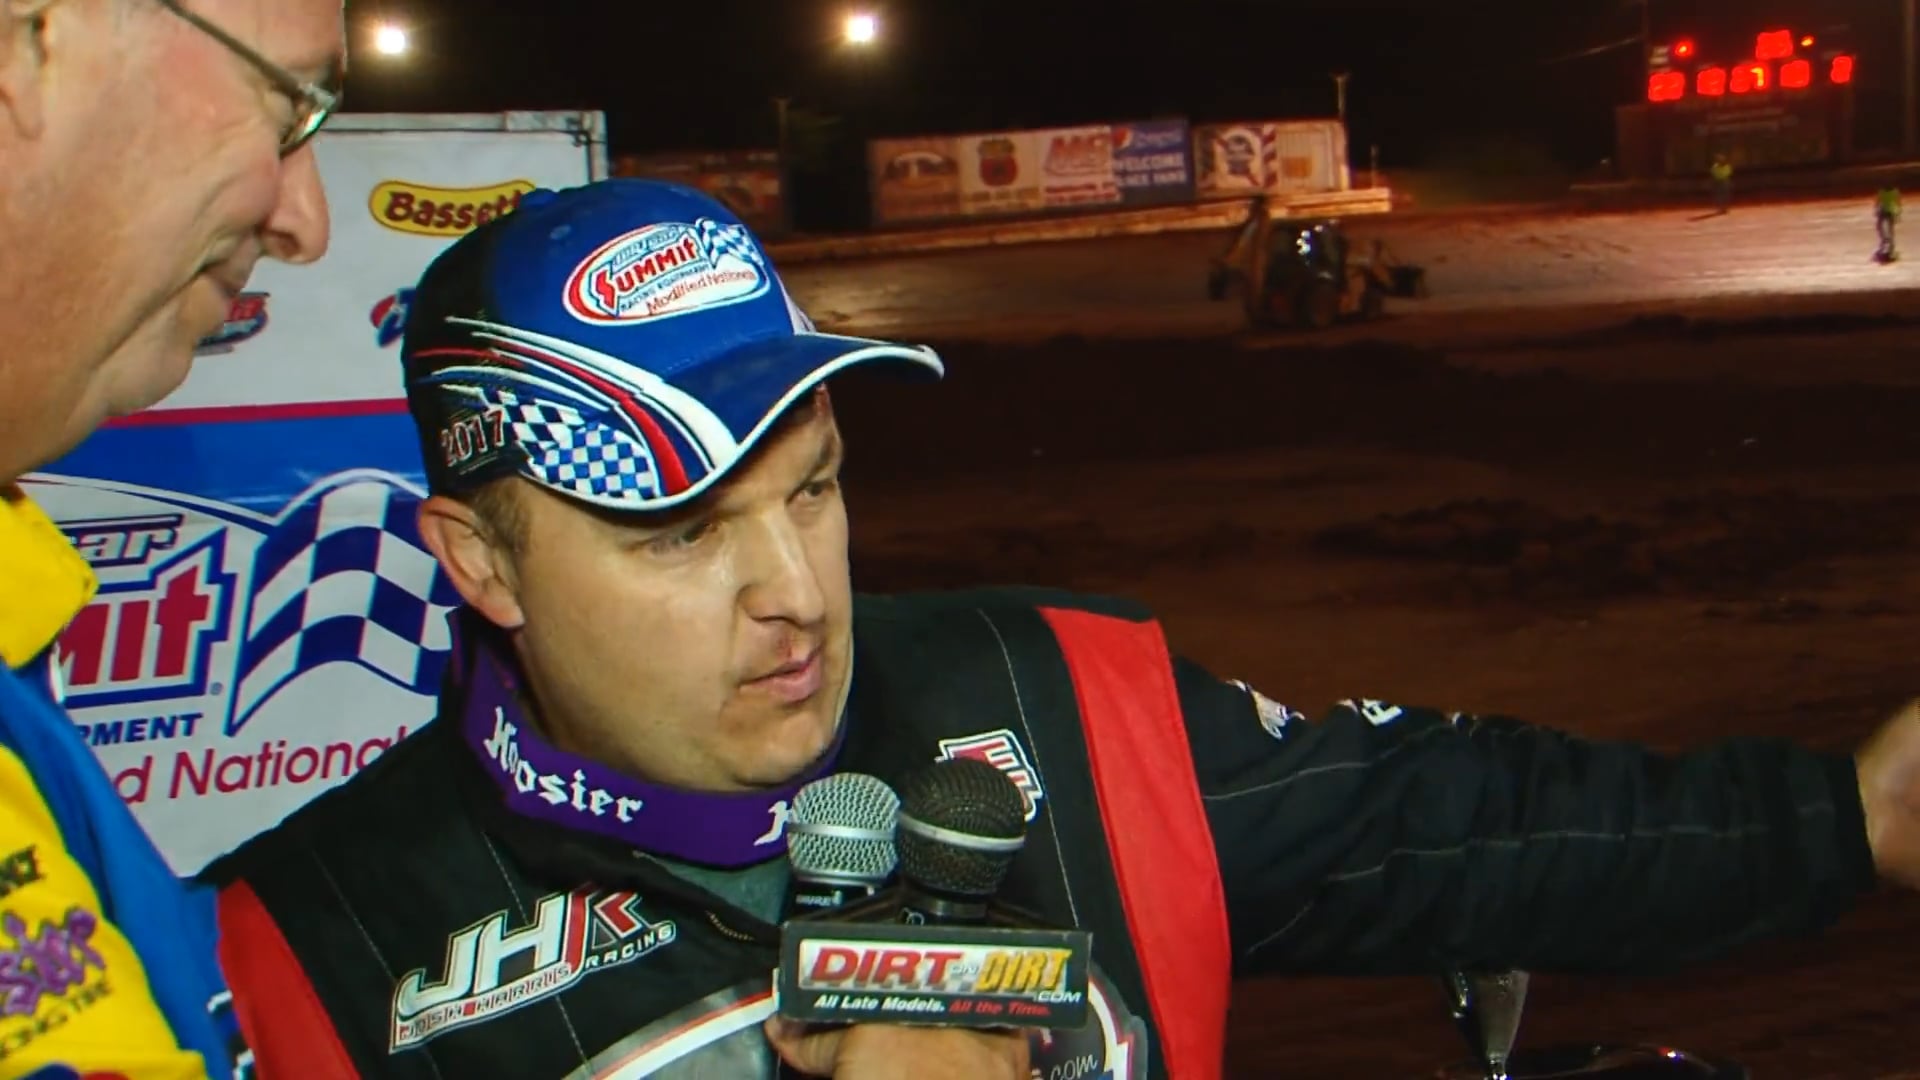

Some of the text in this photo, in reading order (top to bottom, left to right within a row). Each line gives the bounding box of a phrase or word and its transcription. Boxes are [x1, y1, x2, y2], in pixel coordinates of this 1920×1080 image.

[441, 409, 505, 467] 2017
[483, 706, 643, 823] Hoosier
[584, 919, 673, 970] RACING
[810, 947, 963, 985] DIRT
[974, 951, 1071, 992] DIRT
[814, 995, 1052, 1017] All Late Models. All the Time.
